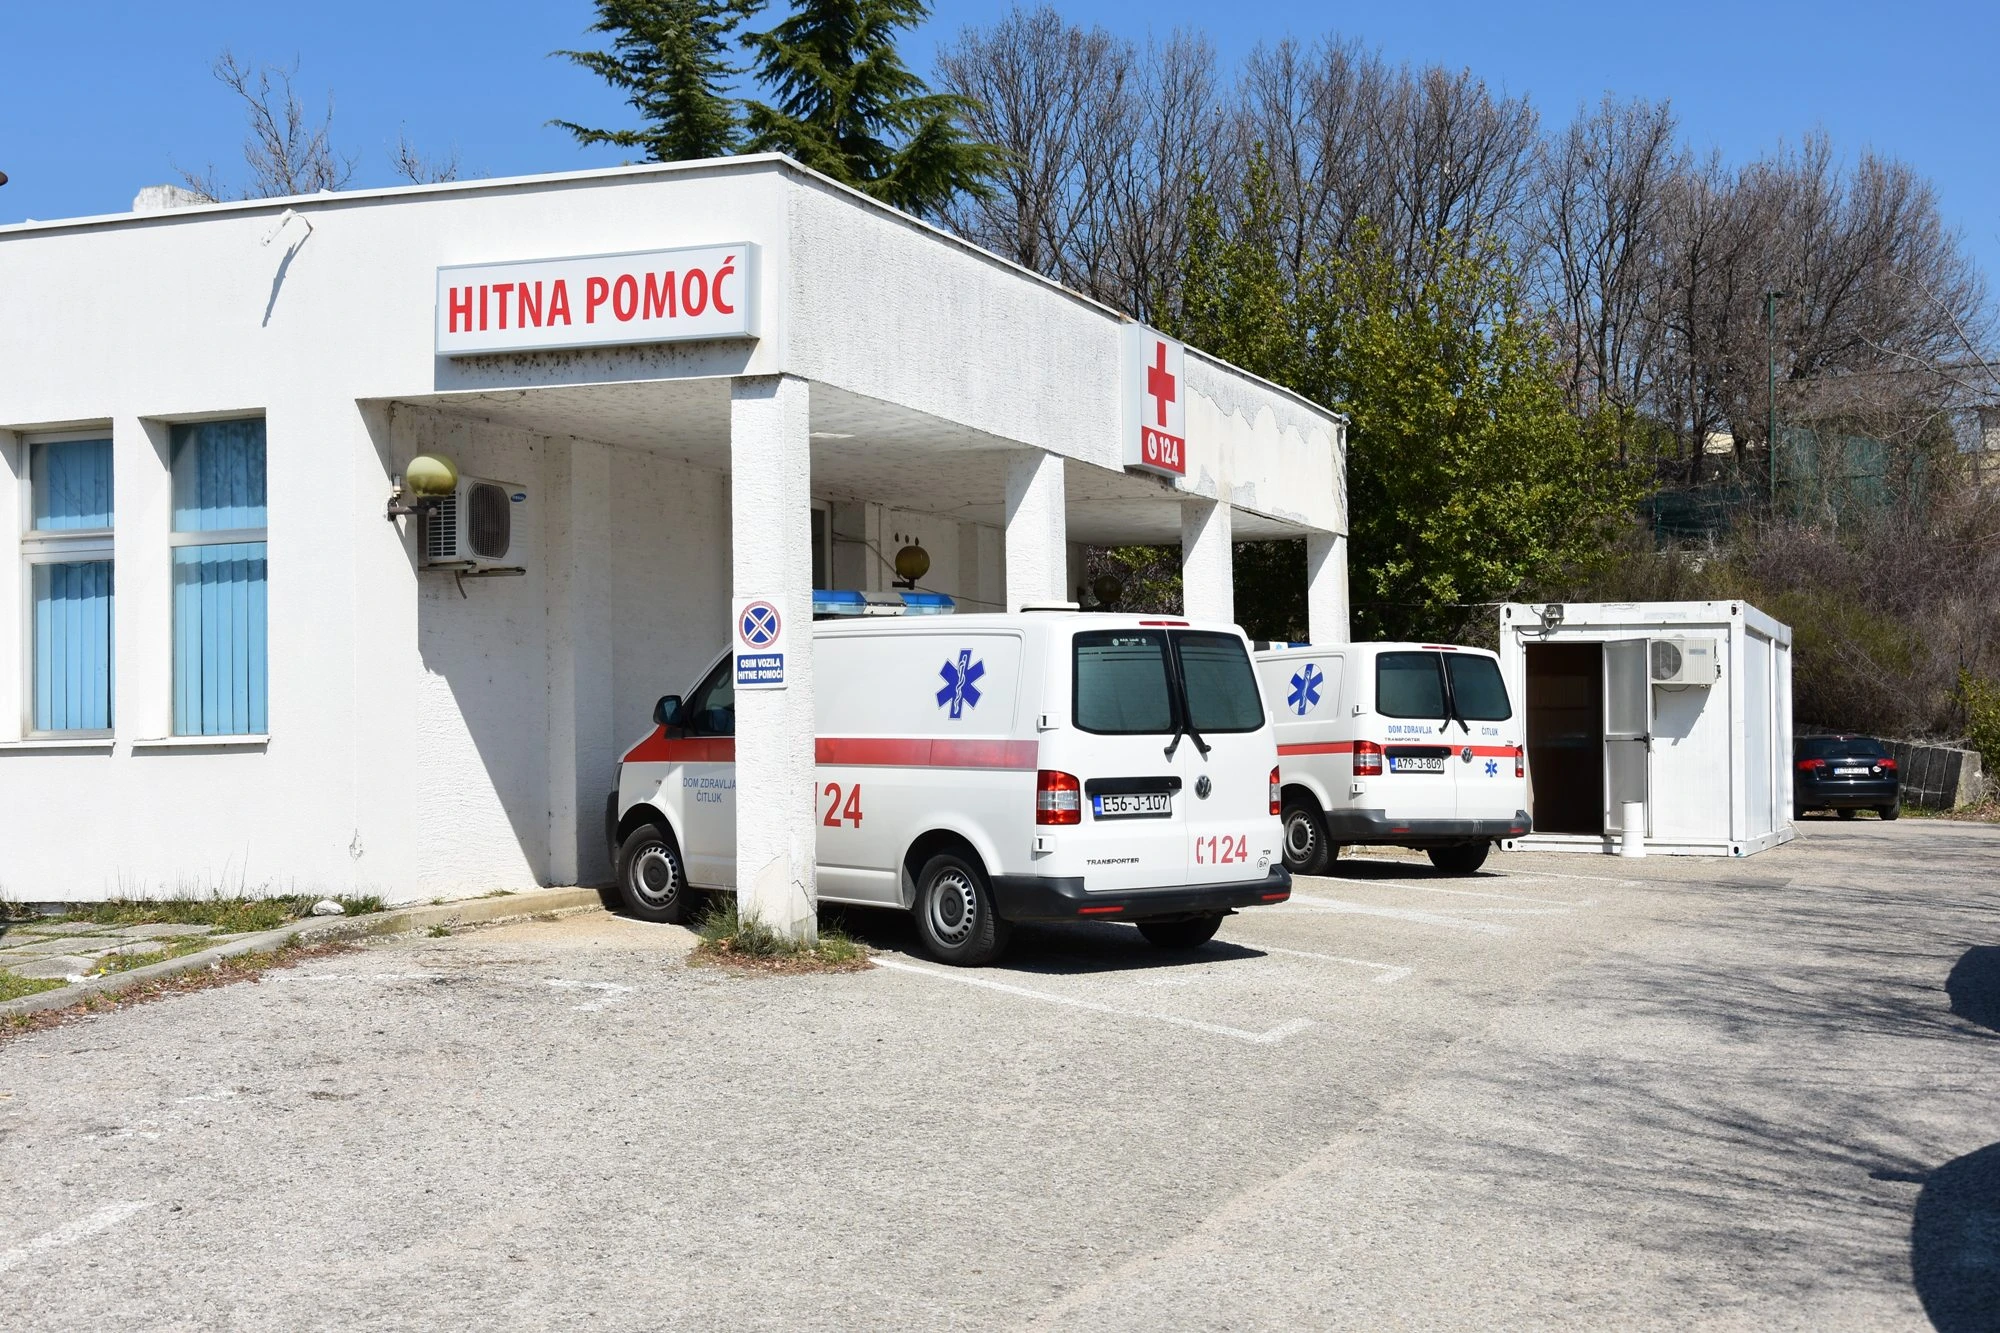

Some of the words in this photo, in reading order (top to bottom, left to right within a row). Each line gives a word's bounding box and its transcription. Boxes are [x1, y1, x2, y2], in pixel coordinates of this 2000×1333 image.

[449, 279, 572, 333] HITNA
[586, 255, 736, 324] POMOĆ
[1160, 437, 1178, 466] 124
[740, 659, 757, 668] OSIM
[757, 658, 781, 668] VOZILA
[738, 671, 758, 680] HITNE
[758, 668, 783, 679] POMOĆI
[1388, 725, 1402, 734] DOM
[1404, 725, 1433, 734] ZDRAVLJA
[1481, 726, 1498, 736] ČITLUK
[1397, 758, 1442, 769] A79-J-809
[683, 777, 699, 788] DOM
[700, 778, 736, 790] ZDRAVLJA
[696, 789, 722, 803] ČITLUK
[1103, 795, 1167, 812] E56-J-107
[1208, 835, 1247, 864] 124
